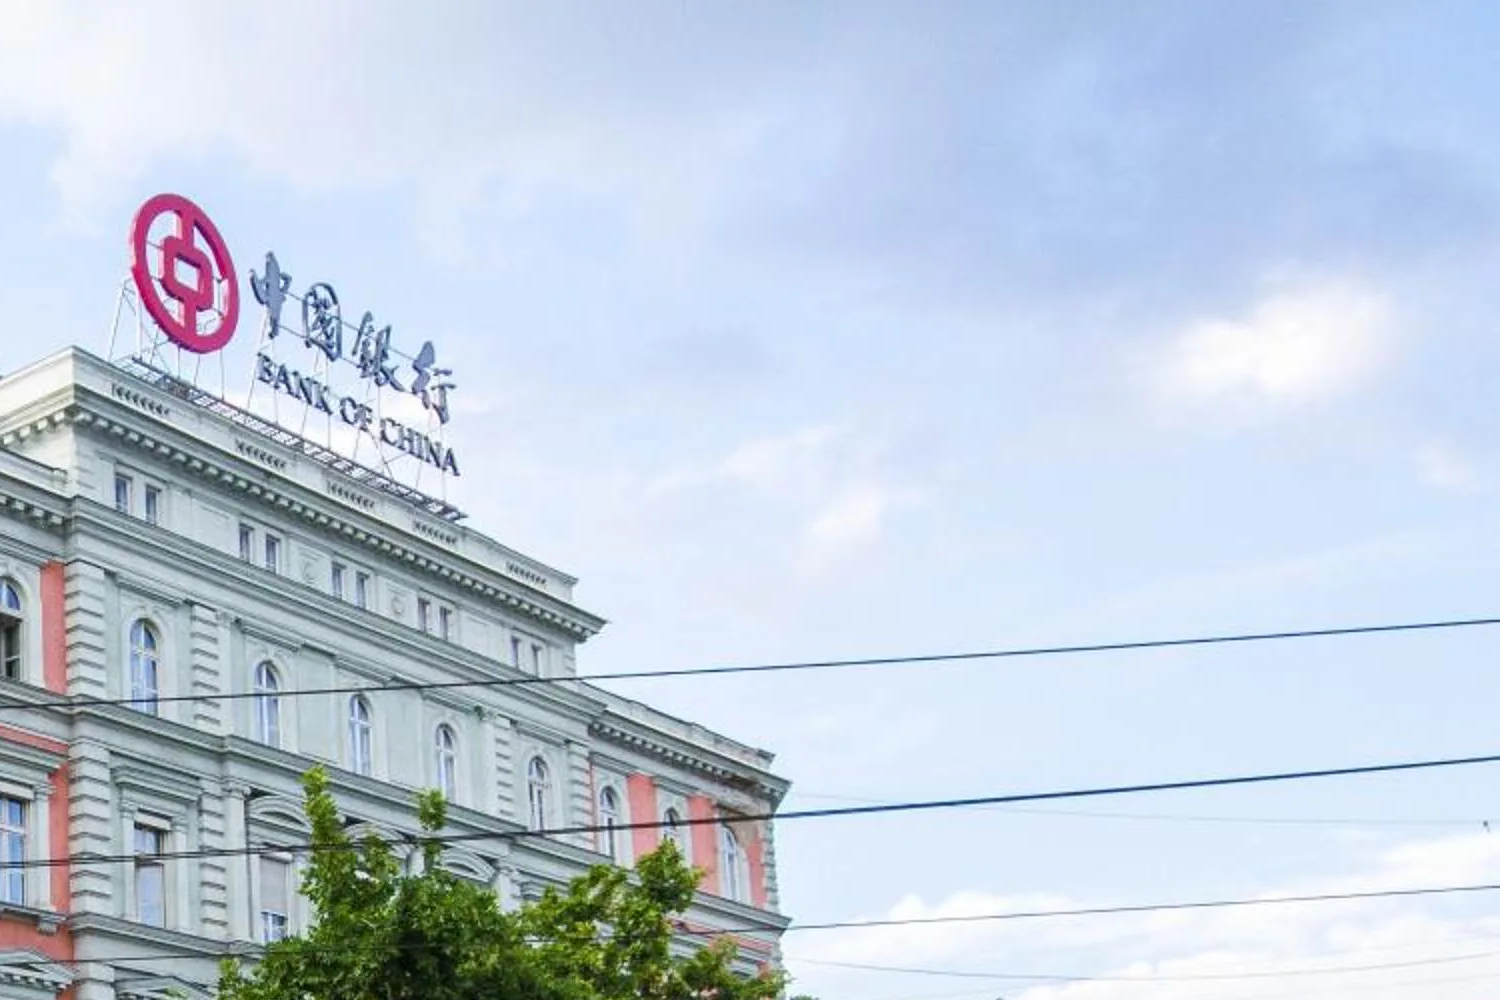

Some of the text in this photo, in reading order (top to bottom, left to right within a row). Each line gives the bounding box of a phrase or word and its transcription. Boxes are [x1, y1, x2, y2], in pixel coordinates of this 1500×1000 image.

[257, 351, 461, 477] BANK OF CHINA
